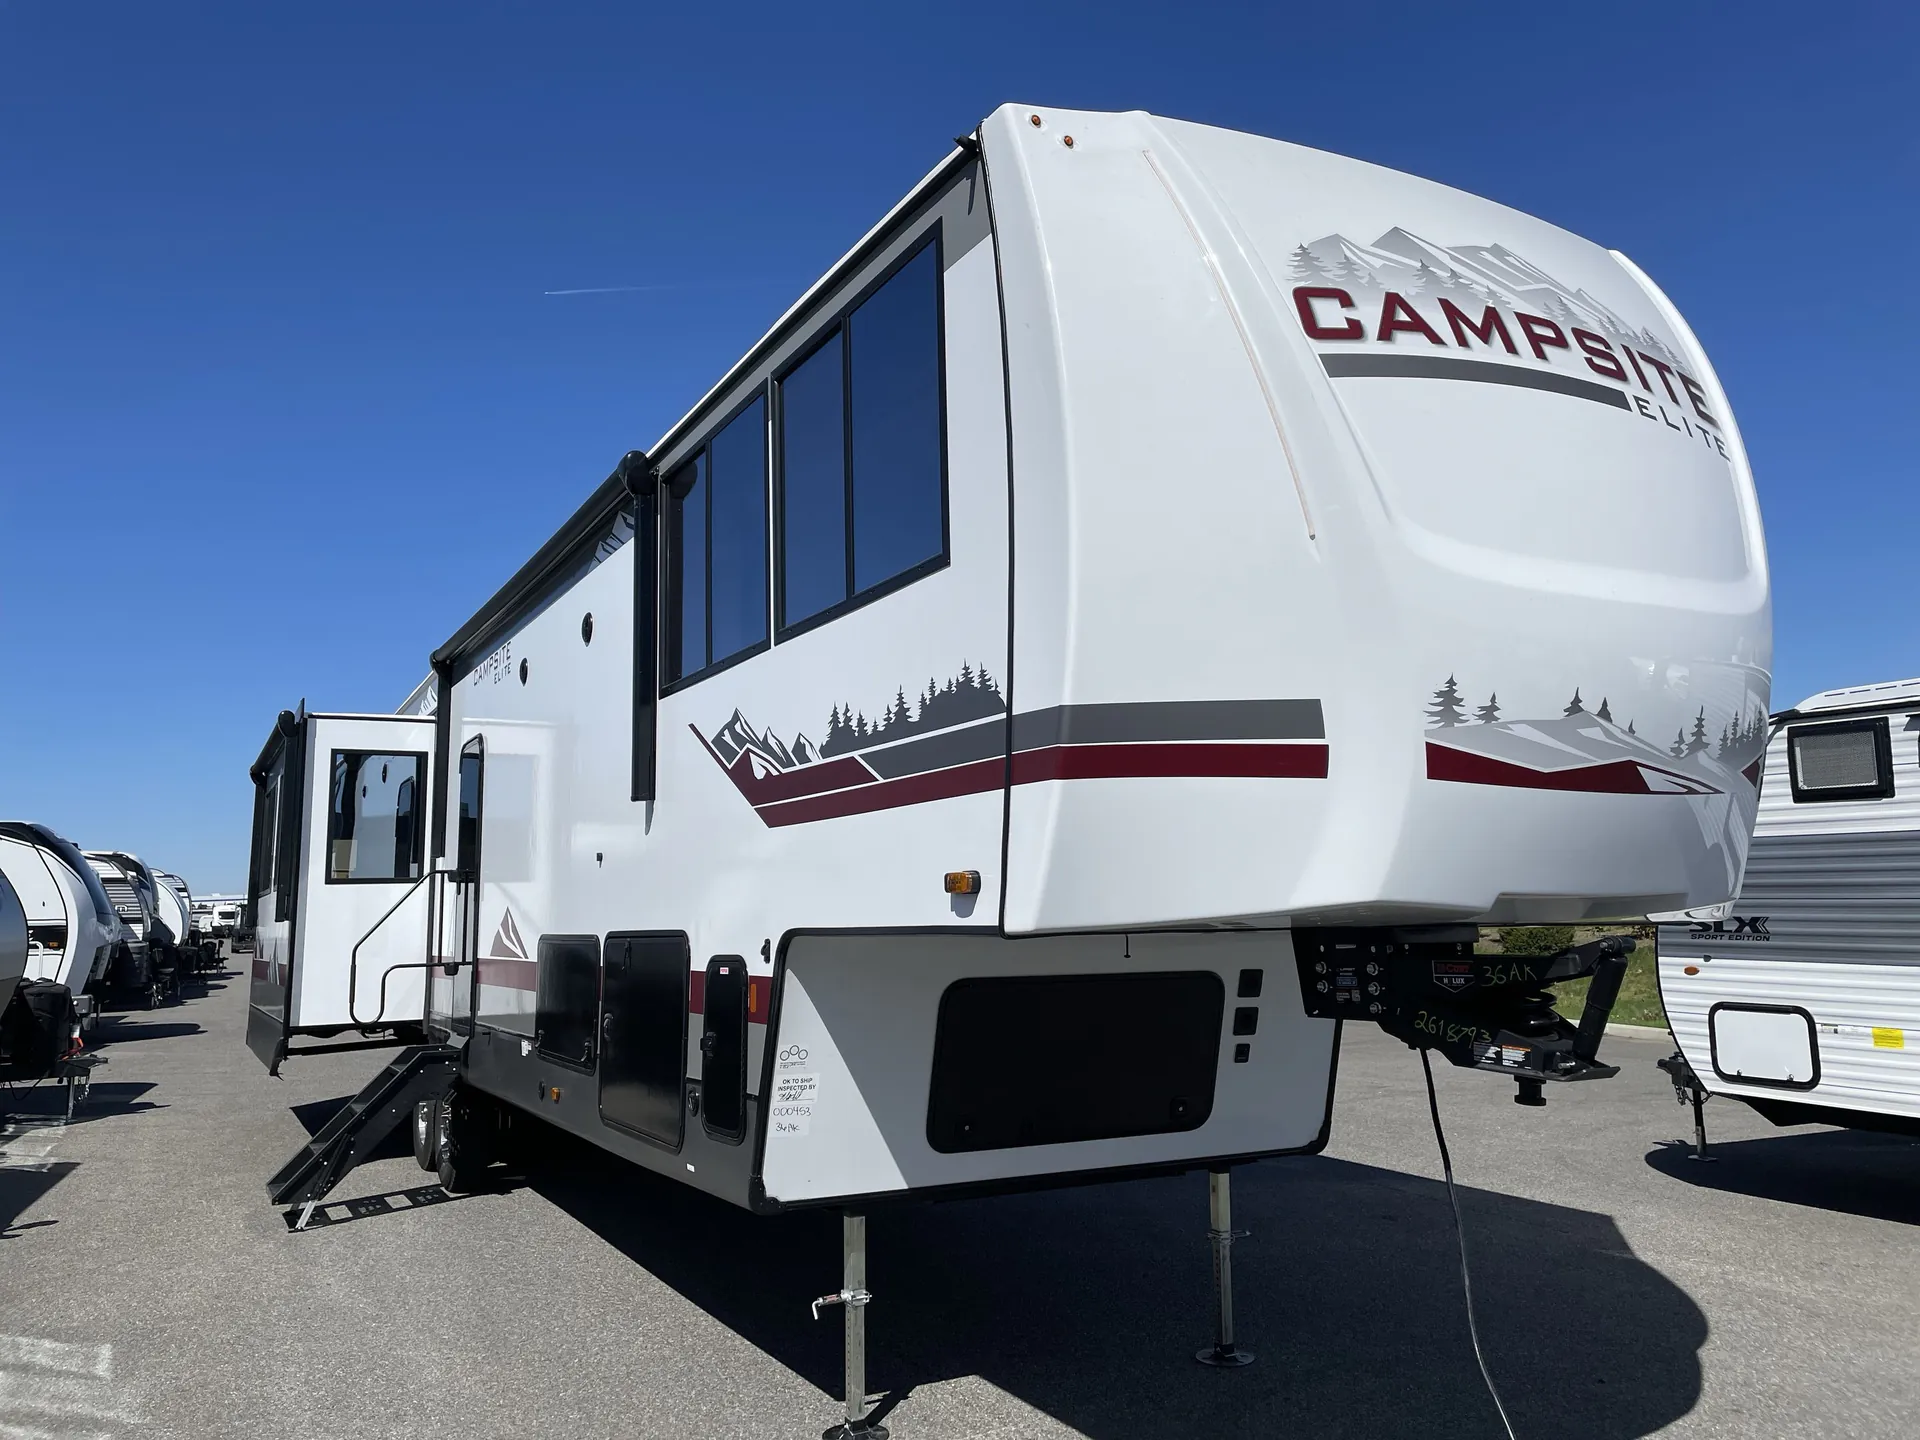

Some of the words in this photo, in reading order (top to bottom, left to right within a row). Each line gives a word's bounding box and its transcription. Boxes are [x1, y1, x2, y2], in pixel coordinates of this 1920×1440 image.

[1292, 286, 1721, 430] CAMPSITE
[1632, 395, 1731, 462] ELITE
[474, 640, 511, 686] CAMPSITE
[494, 662, 511, 684] ELITE
[1689, 917, 1770, 933] SLX
[1414, 1010, 1492, 1048] 2618793
